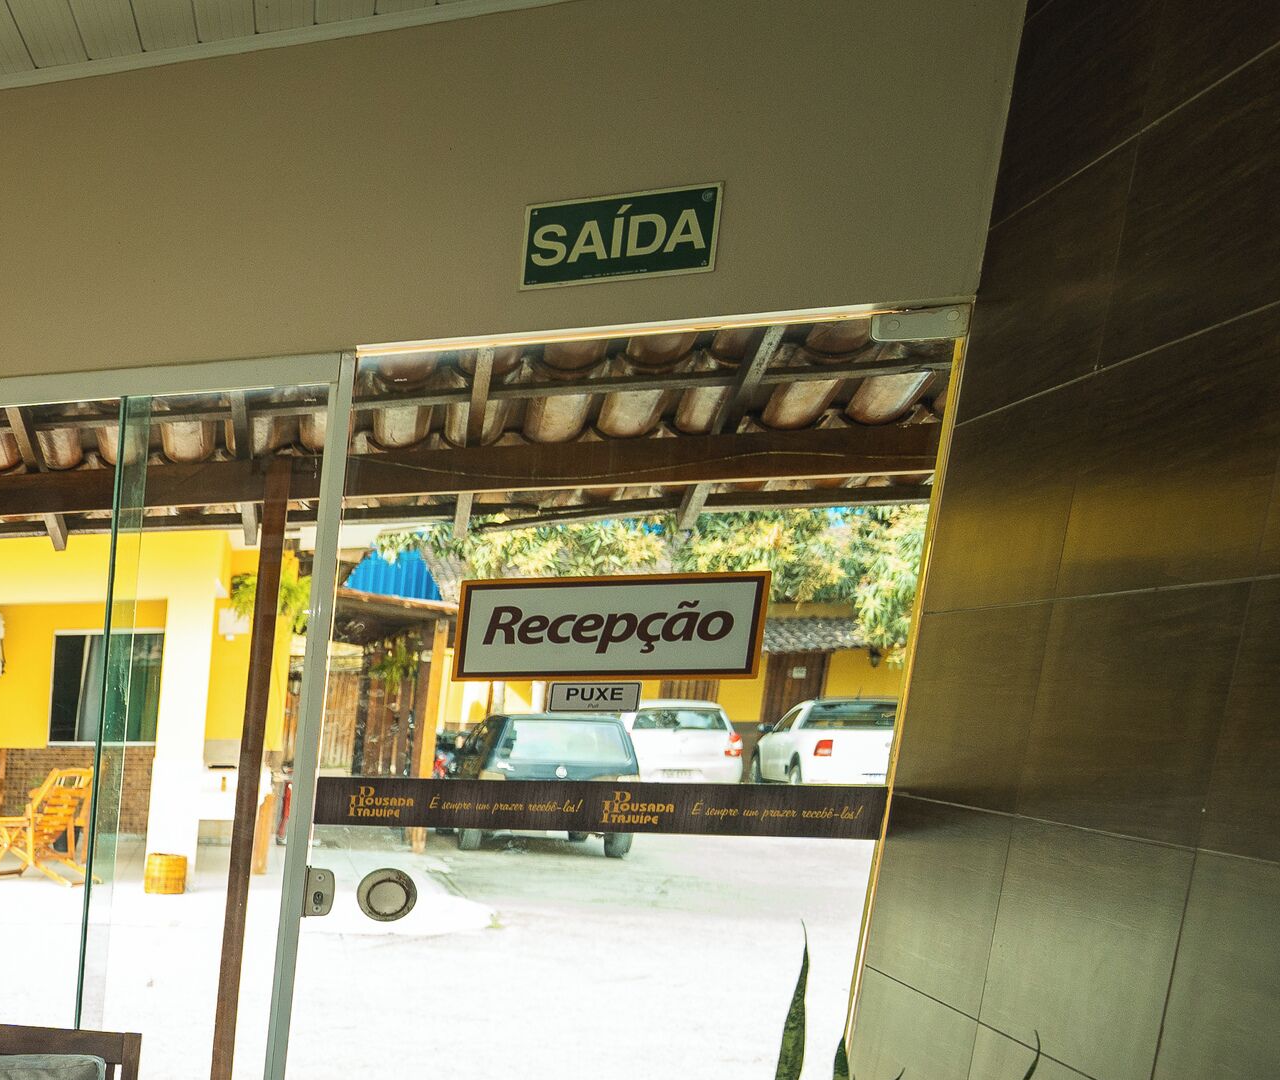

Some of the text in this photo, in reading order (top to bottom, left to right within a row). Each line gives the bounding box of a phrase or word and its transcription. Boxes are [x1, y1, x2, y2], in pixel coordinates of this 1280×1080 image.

[531, 204, 706, 266] SAÍDA
[483, 600, 735, 654] Recepção
[566, 687, 624, 701] PUXE
[429, 794, 583, 814] É sempre um prazer recebê-los!
[691, 800, 864, 821] É sempre um prazer recebê-los!
